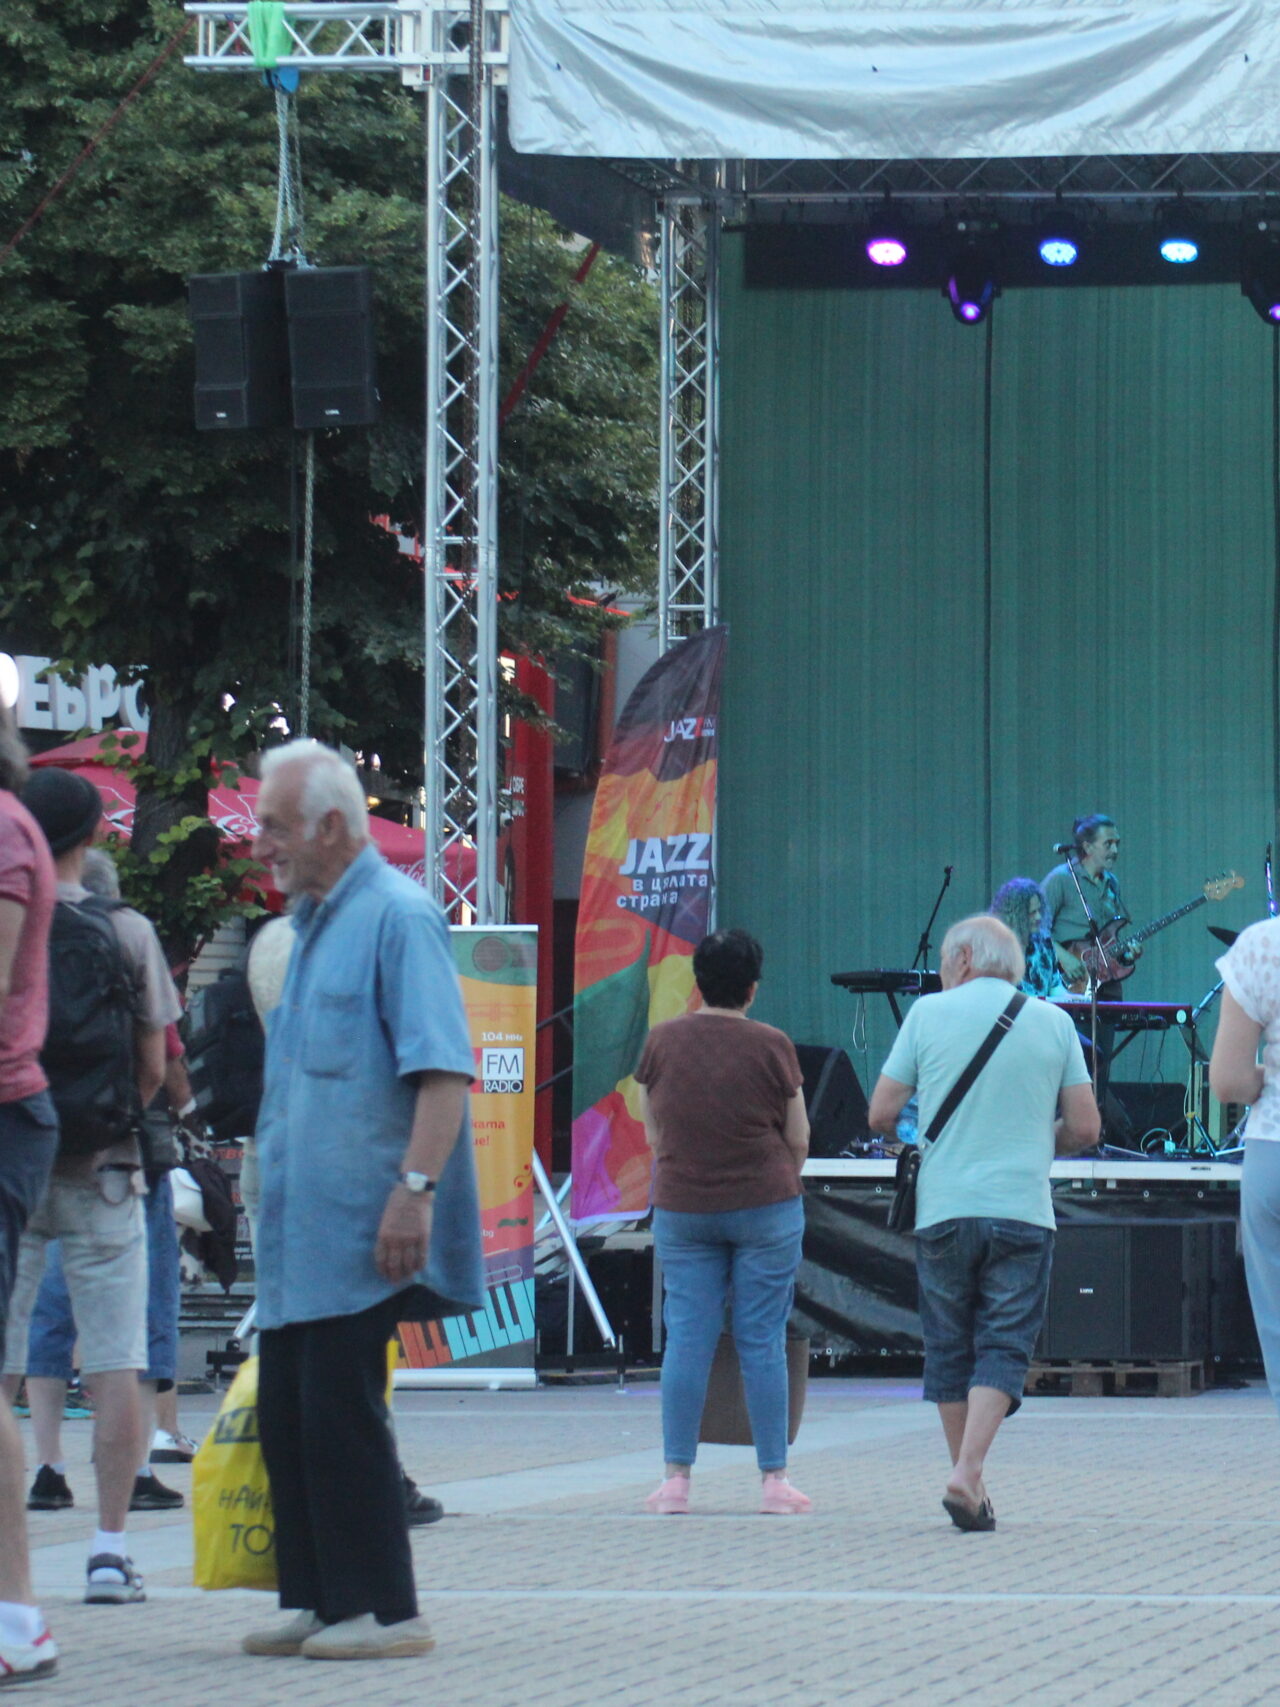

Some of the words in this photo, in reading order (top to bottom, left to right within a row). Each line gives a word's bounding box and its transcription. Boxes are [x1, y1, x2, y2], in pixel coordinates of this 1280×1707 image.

[618, 832, 711, 875] JAZZ
[633, 879, 643, 892] в
[483, 1031, 503, 1041] 104
[487, 1054, 520, 1075] FM
[484, 1080, 523, 1093] RADIO
